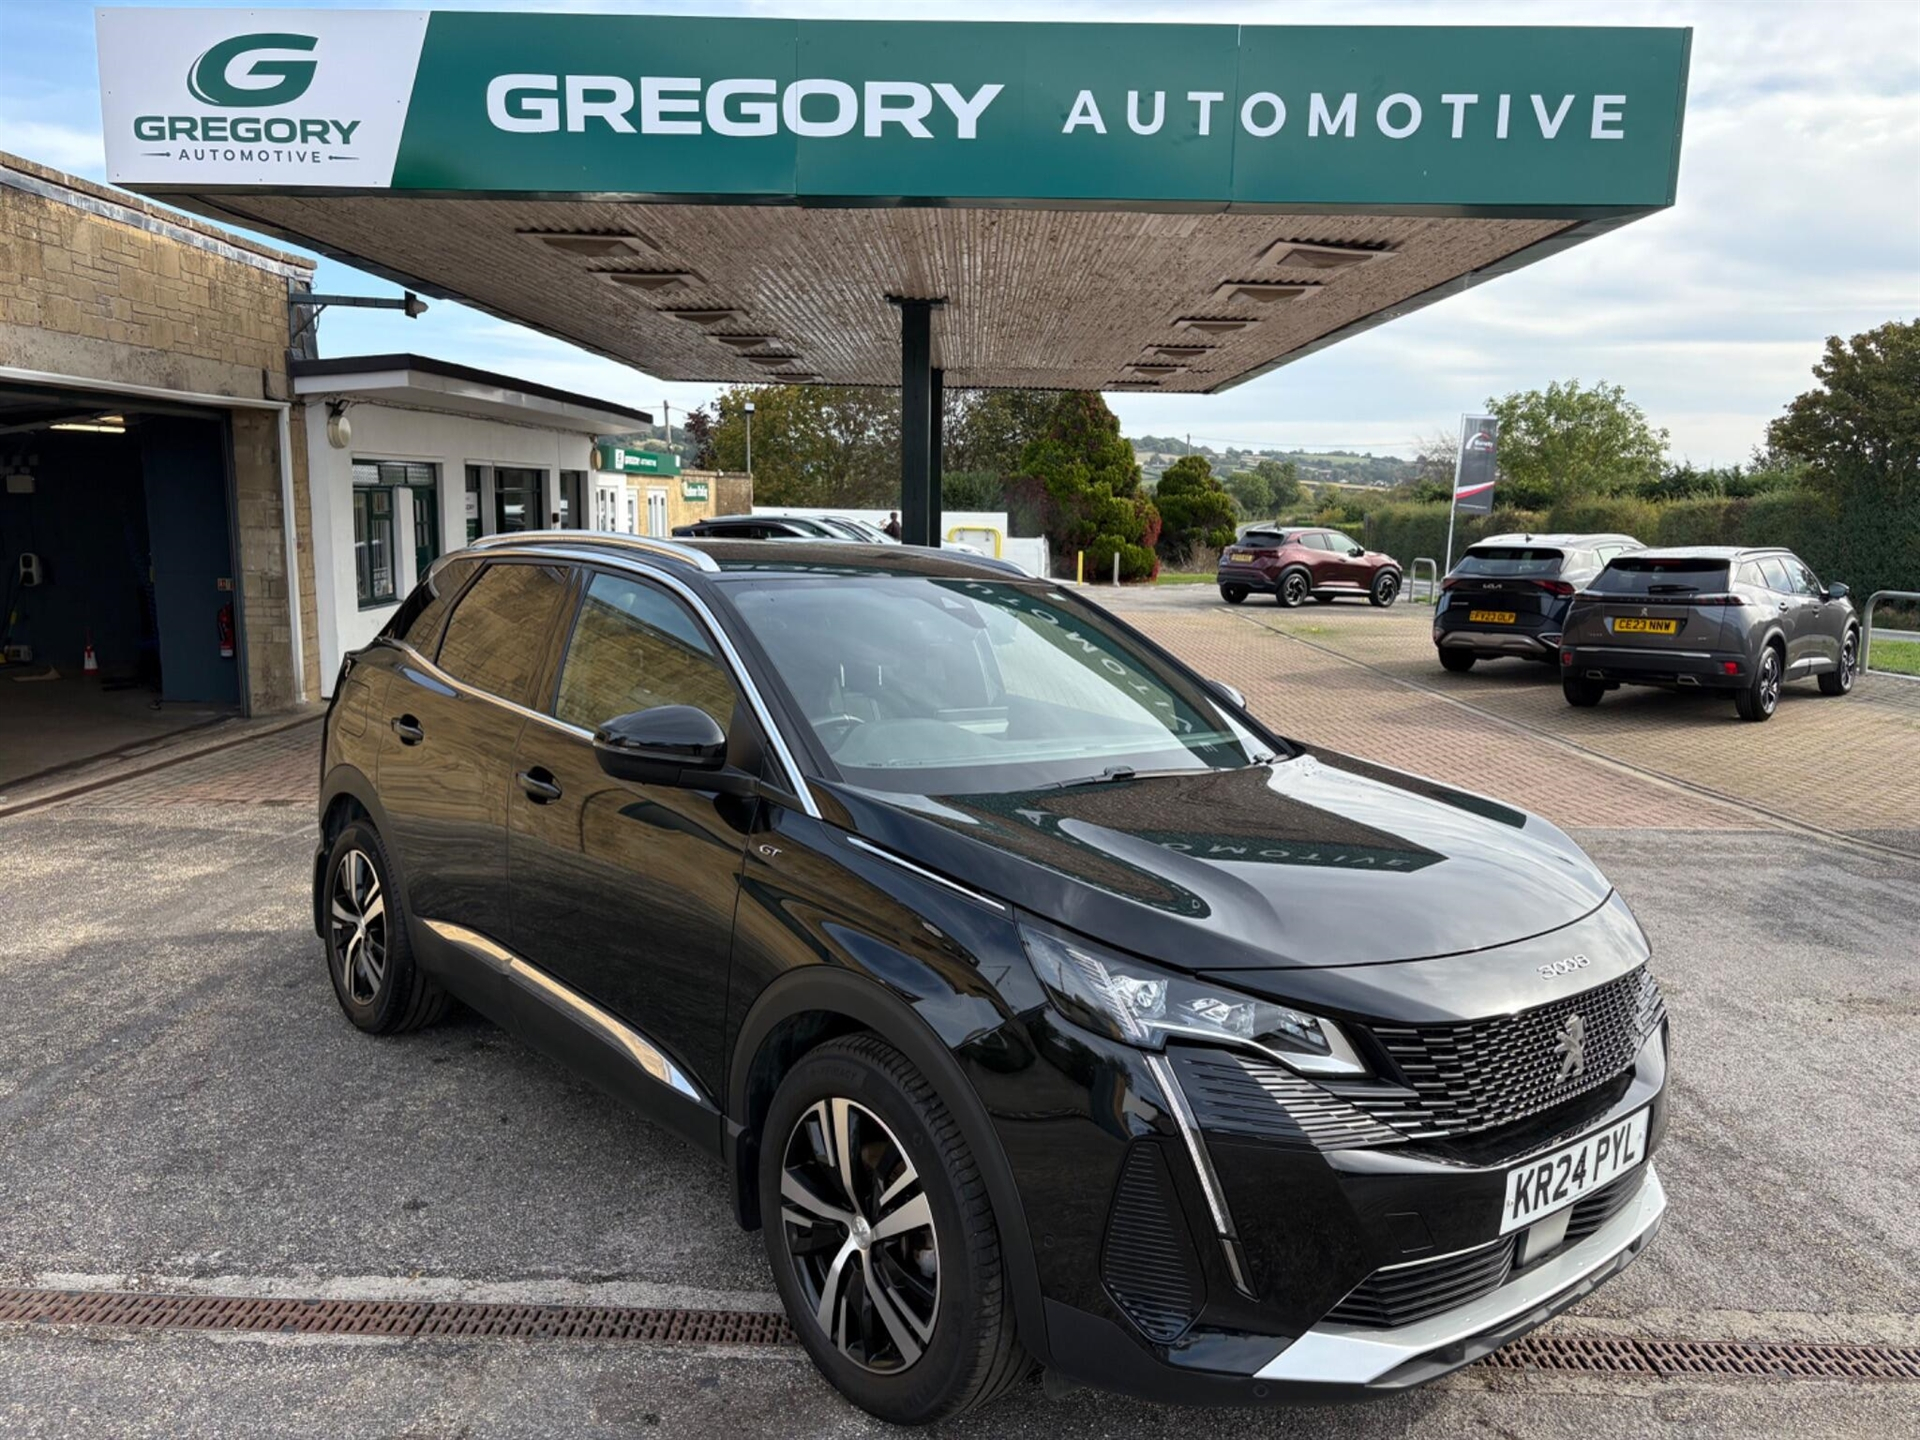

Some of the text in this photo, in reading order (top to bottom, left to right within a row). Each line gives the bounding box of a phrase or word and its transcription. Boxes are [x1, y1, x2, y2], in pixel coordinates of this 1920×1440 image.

[486, 73, 1627, 141] GREGORY AUTOMOTIVE
[134, 116, 361, 145] GREGORY
[178, 147, 321, 163] AUTOMOTIVE
[1618, 619, 1671, 631] CE23 NNW
[759, 844, 783, 858] GT
[1536, 953, 1591, 980] 3008
[1512, 1122, 1635, 1220] KR24 PYL
